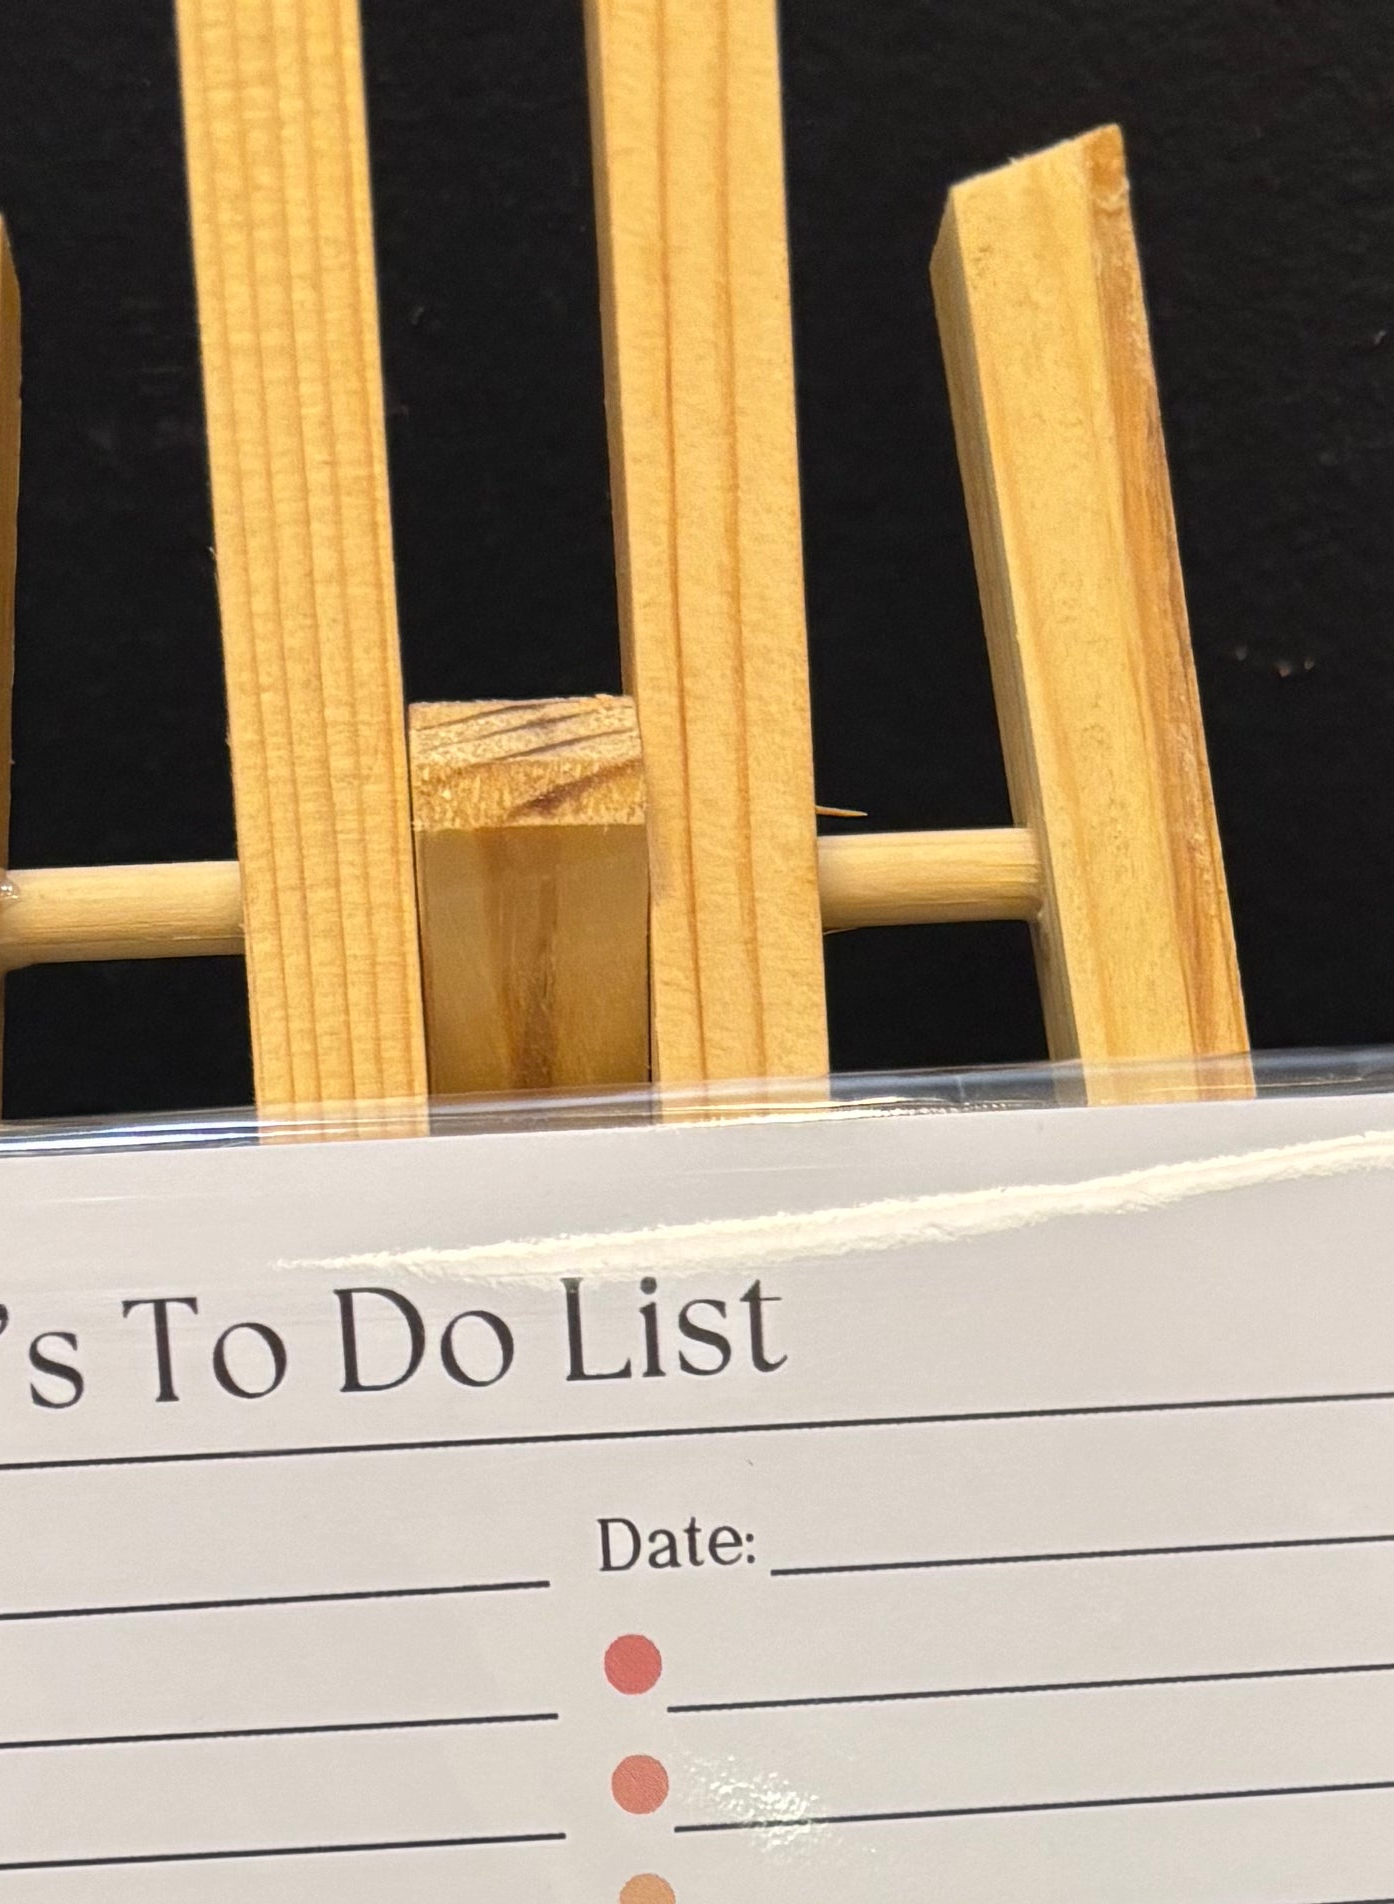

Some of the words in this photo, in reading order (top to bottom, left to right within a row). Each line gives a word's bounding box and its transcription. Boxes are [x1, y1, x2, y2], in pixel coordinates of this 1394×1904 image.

[120, 1296, 288, 1403] To
[332, 1286, 516, 1393] Do
[561, 1276, 789, 1382] List
[596, 1516, 756, 1572] Date:
